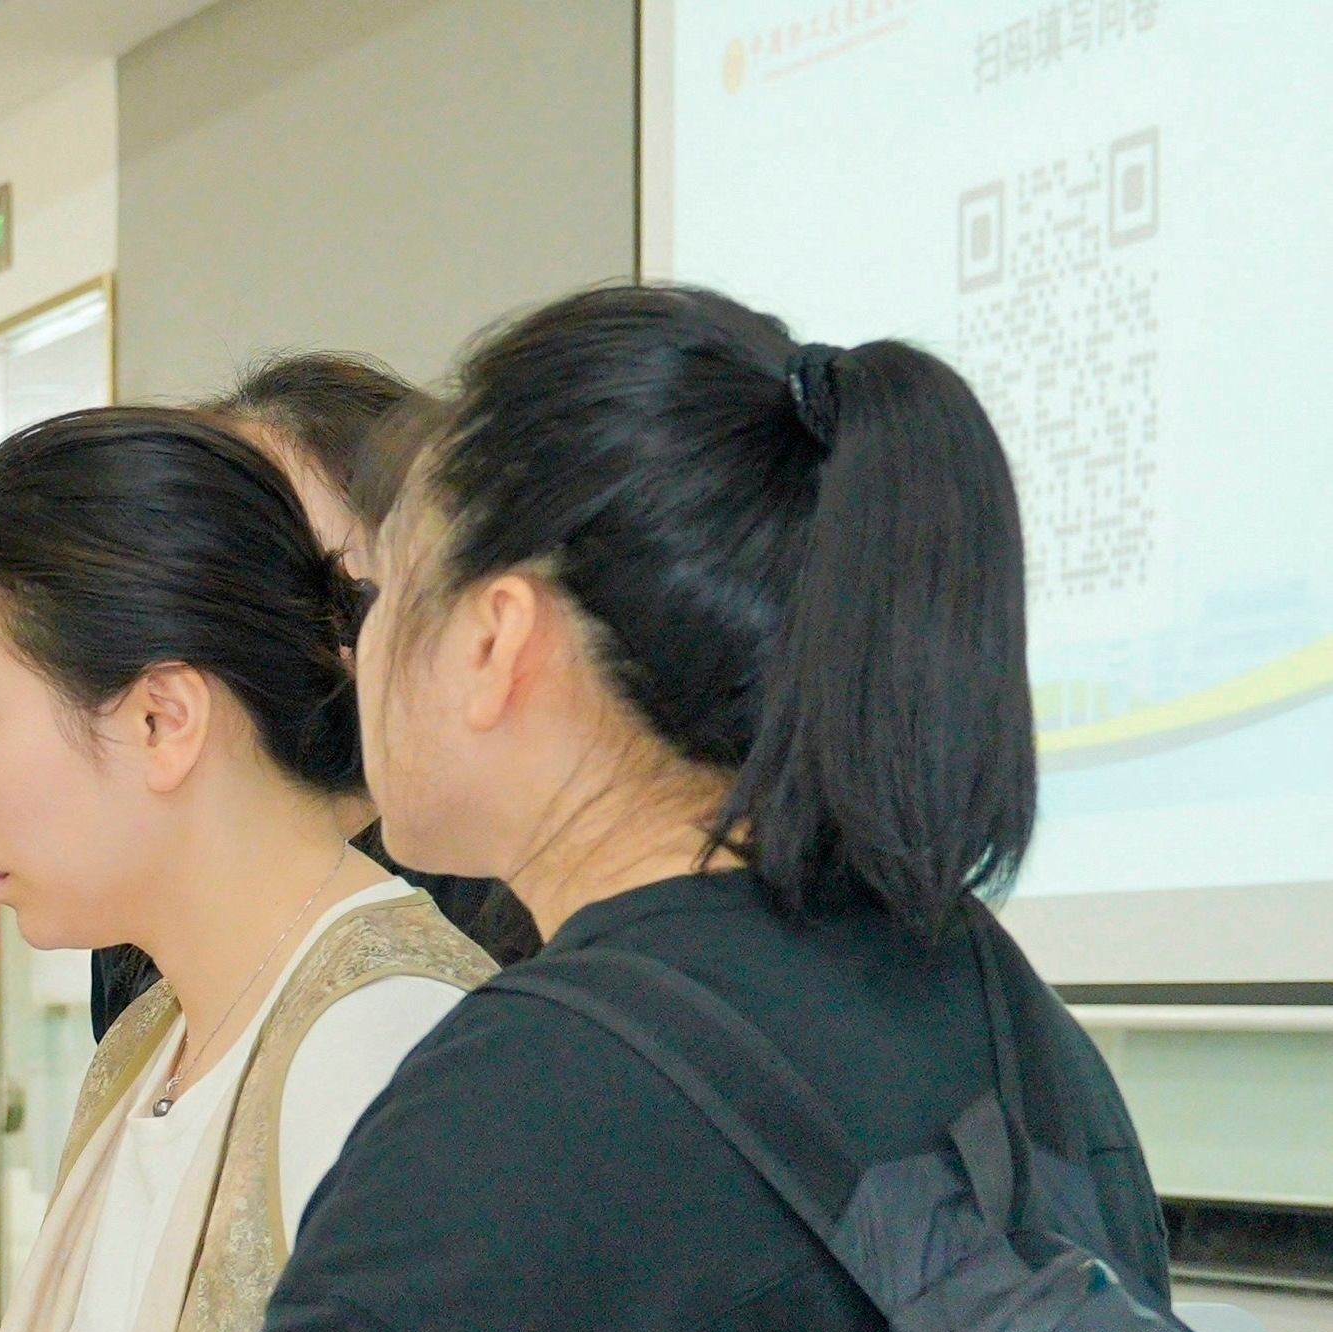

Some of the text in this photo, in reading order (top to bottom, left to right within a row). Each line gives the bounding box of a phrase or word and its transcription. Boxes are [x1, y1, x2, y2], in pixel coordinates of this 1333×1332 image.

[974, 0, 1161, 92] 扫码填写问卷
